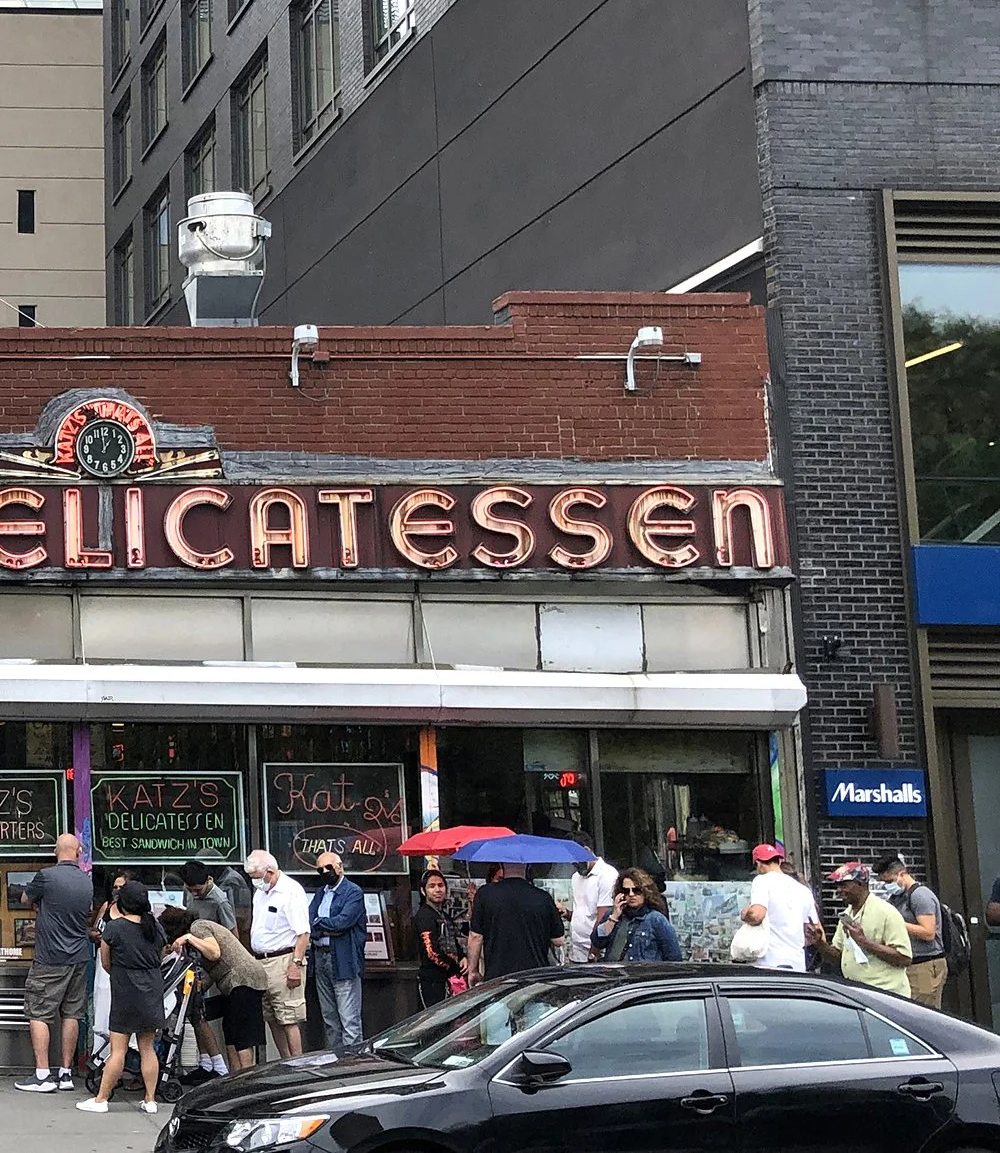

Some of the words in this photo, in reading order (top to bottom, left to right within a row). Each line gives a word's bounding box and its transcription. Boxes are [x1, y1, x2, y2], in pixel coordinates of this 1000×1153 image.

[94, 430, 99, 438] 11
[101, 427, 108, 436] 12
[85, 435, 93, 444] 10
[118, 435, 123, 443] 2
[84, 445, 89, 453] 9
[121, 445, 126, 453] 3
[87, 455, 92, 464] 8
[118, 454, 123, 463] 4
[94, 461, 100, 469] 7
[102, 463, 108, 472] 6
[111, 460, 116, 469] 5
[108, 778, 219, 811] KATZ'S
[831, 782, 922, 804] Marshalls
[107, 812, 225, 831] DELICATESSEN
[102, 837, 126, 849] BEST
[131, 837, 185, 851] SANDWICH
[186, 839, 198, 850] IN
[200, 837, 231, 850] TOWN
[351, 839, 376, 856] ALL
